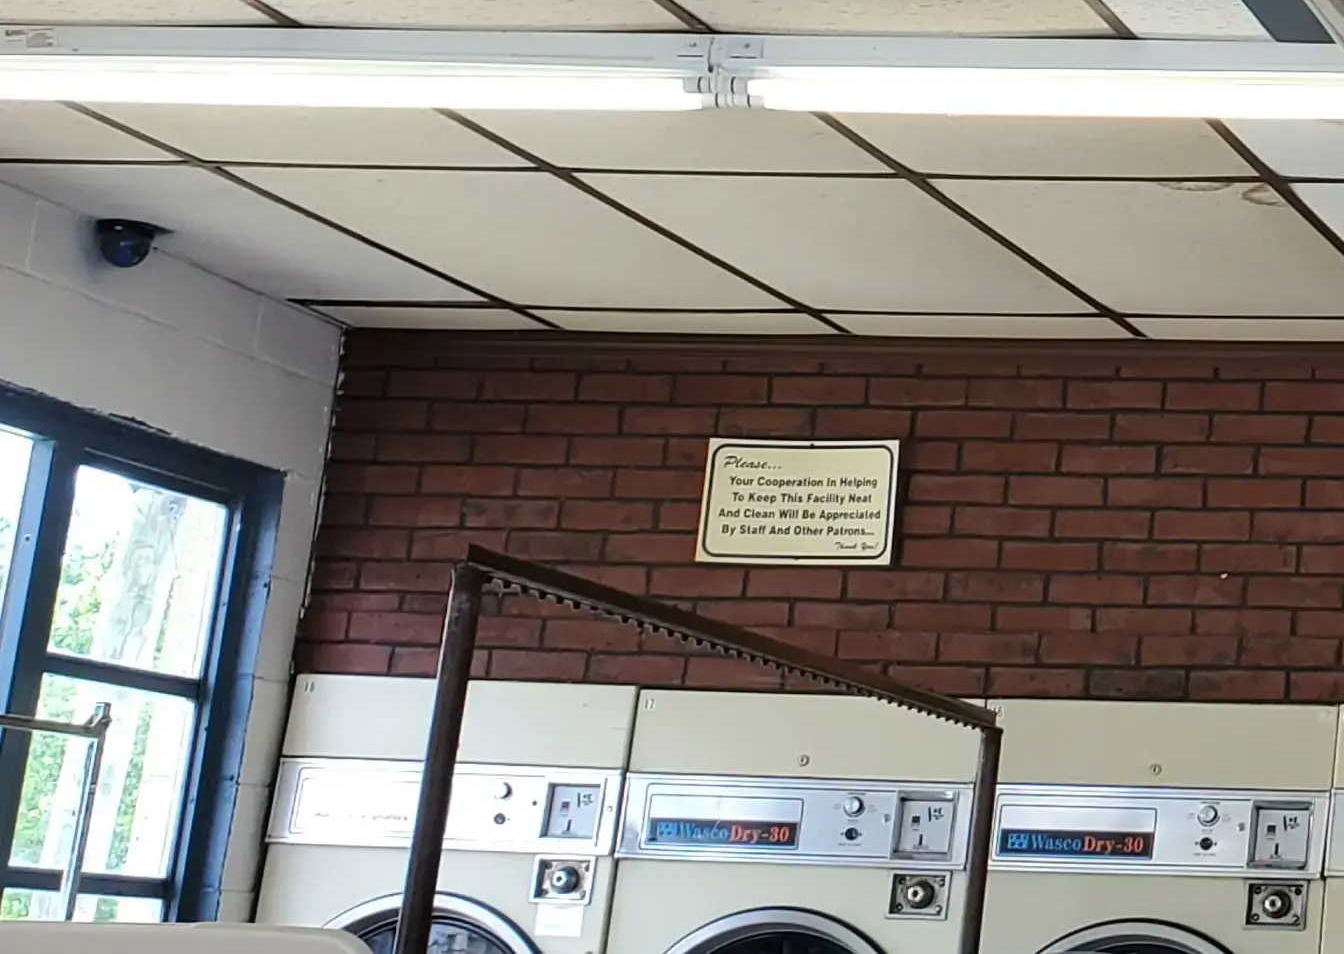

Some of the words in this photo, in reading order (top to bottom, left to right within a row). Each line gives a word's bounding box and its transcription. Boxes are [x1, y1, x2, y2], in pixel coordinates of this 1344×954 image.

[729, 475, 754, 487] Your
[757, 476, 823, 488] Cooperation
[826, 477, 837, 487] In
[840, 477, 878, 489] Helping
[732, 492, 745, 502] To
[748, 492, 777, 504] Keep
[781, 493, 803, 503] This
[806, 493, 845, 505] Facility
[848, 494, 872, 504] Neat
[718, 508, 740, 518] And
[743, 509, 775, 519] Clean
[779, 509, 799, 519] Will
[802, 510, 816, 519] Be
[819, 510, 881, 522] Appreciated
[721, 525, 736, 536] By
[739, 525, 767, 535] Staff
[769, 525, 791, 535] And
[794, 526, 823, 536] Other
[834, 542, 857, 550] Thank
[679, 823, 729, 840] Wasco
[1031, 834, 1082, 851] Wasco
